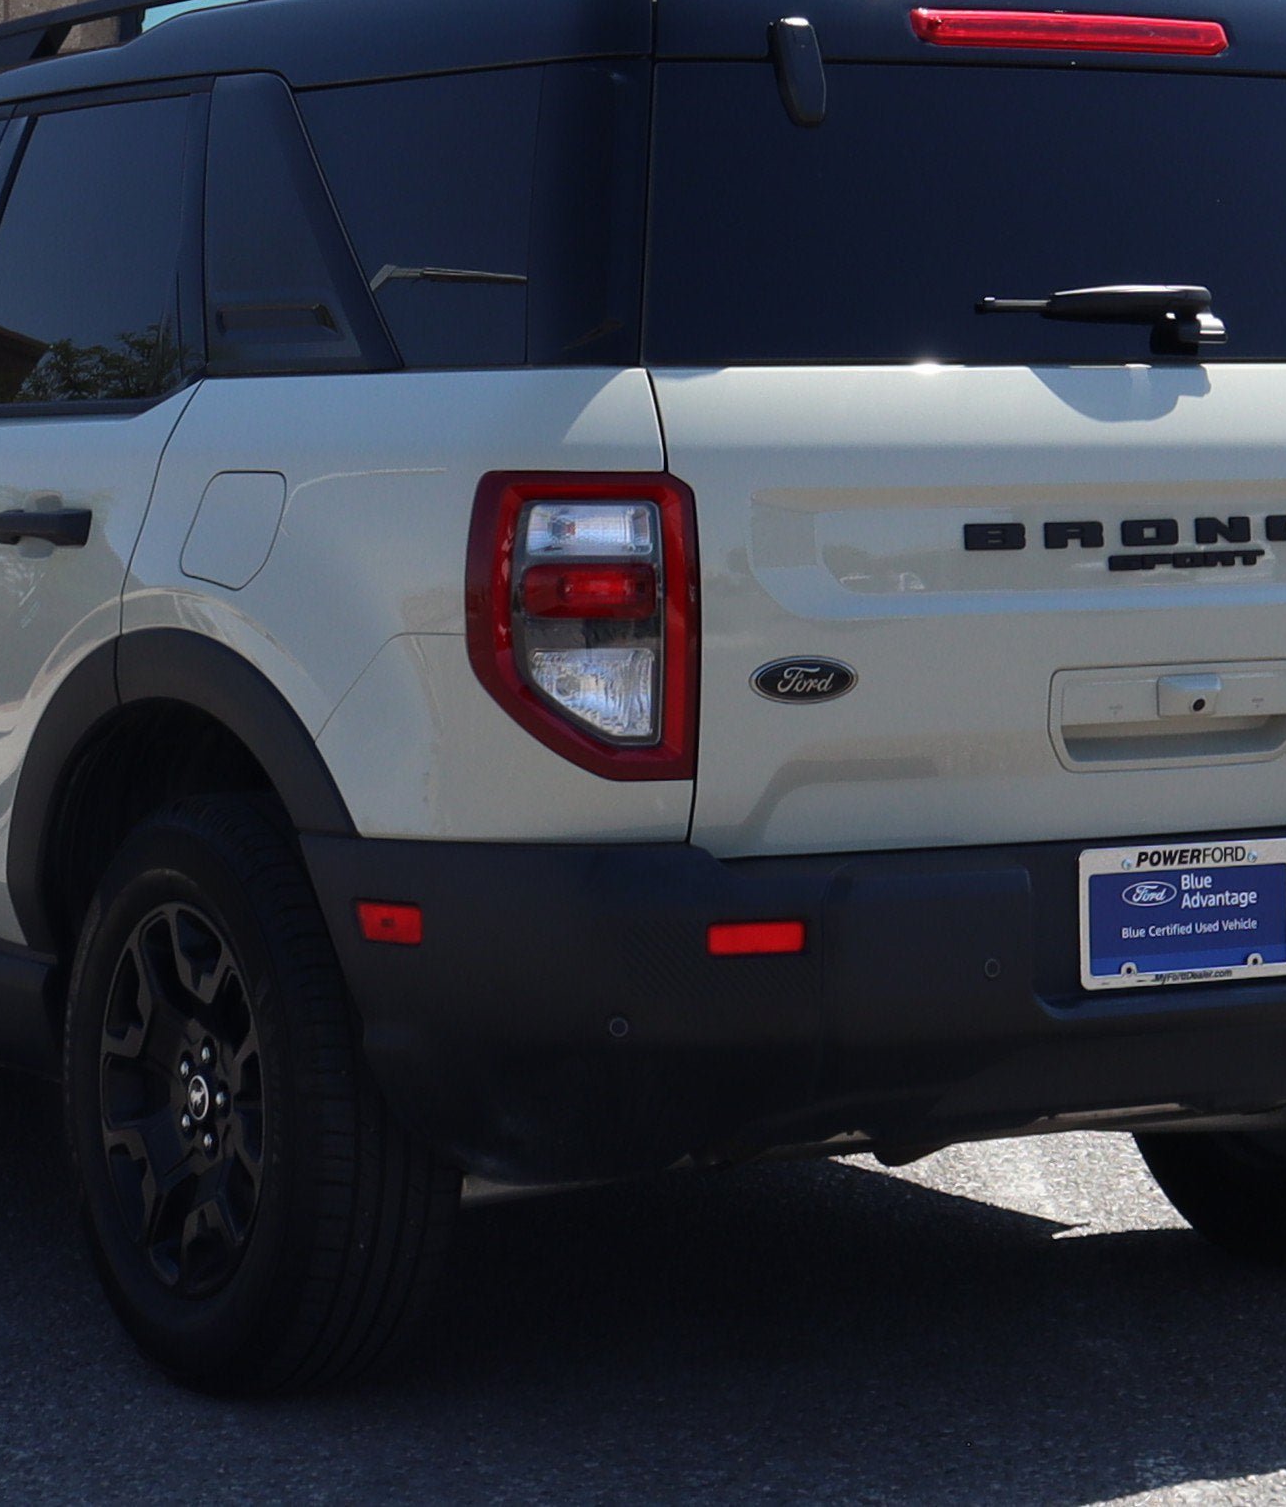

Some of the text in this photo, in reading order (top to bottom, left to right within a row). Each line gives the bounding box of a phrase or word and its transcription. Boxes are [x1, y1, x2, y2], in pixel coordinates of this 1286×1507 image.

[1108, 549, 1265, 571] SPORT
[776, 666, 834, 693] Ford
[1135, 845, 1246, 869] POWERFORD
[1180, 873, 1213, 891] Blue
[1132, 885, 1258, 909] Ford Advantage
[1121, 917, 1258, 939] Blue Certified Used Vehicle
